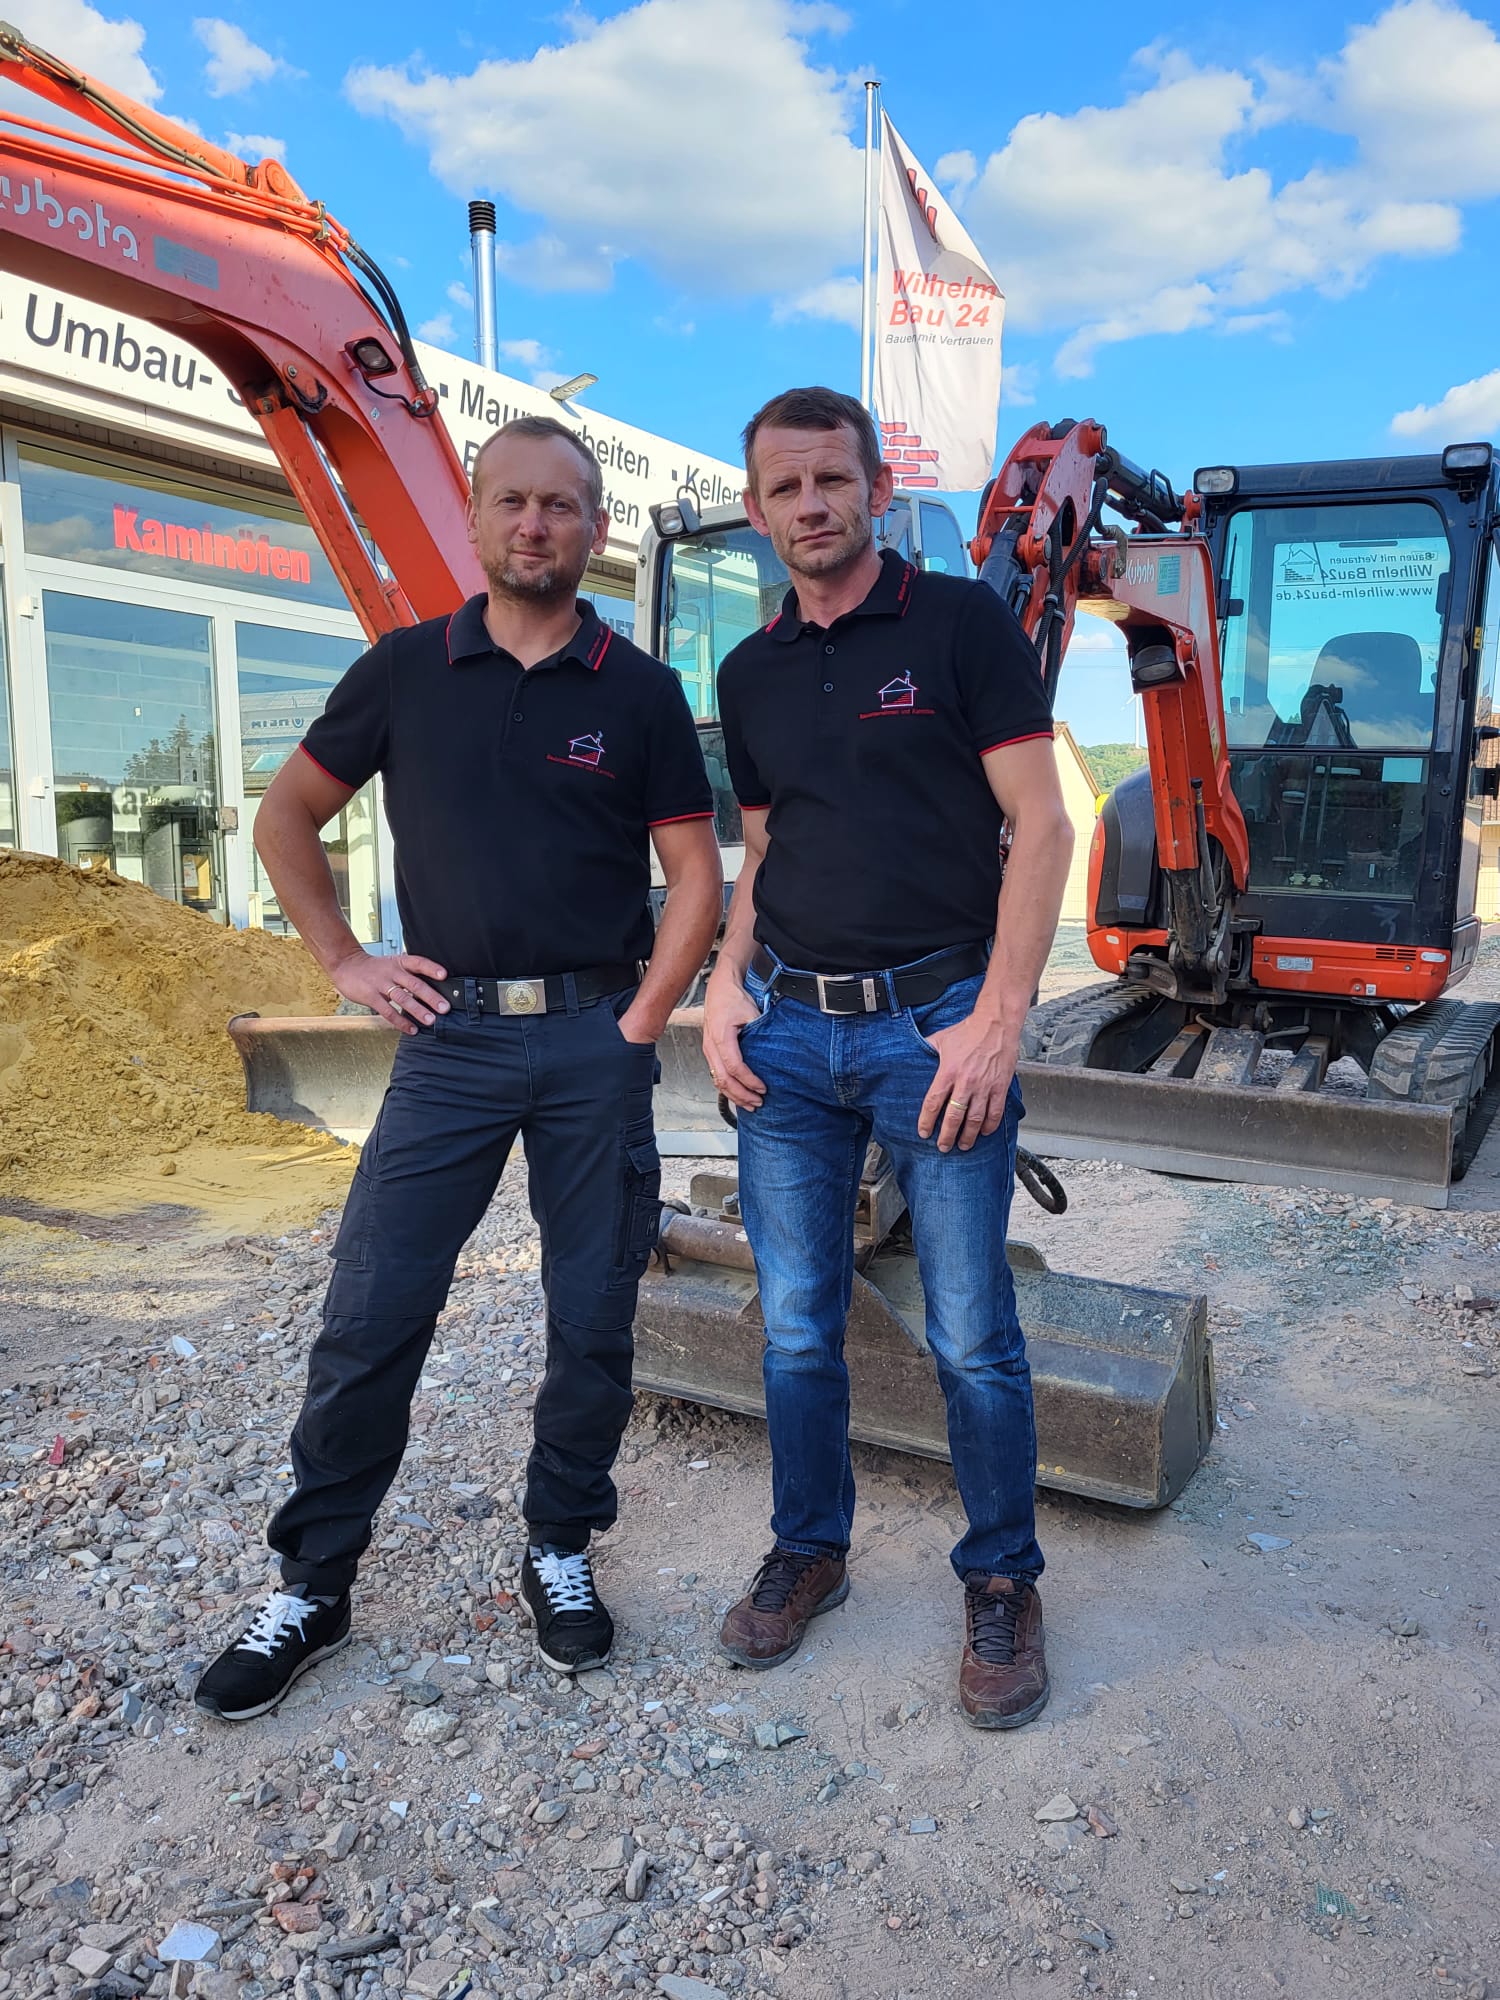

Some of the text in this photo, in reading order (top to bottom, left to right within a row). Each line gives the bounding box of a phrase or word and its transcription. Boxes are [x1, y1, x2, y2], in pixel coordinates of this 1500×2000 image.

[893, 269, 997, 300] Wilhelm
[889, 300, 990, 327] Bau 24
[25, 293, 213, 391] Umbau-
[885, 333, 994, 346] Bauen mit Vertrauen
[113, 503, 311, 584] Kaminöfen
